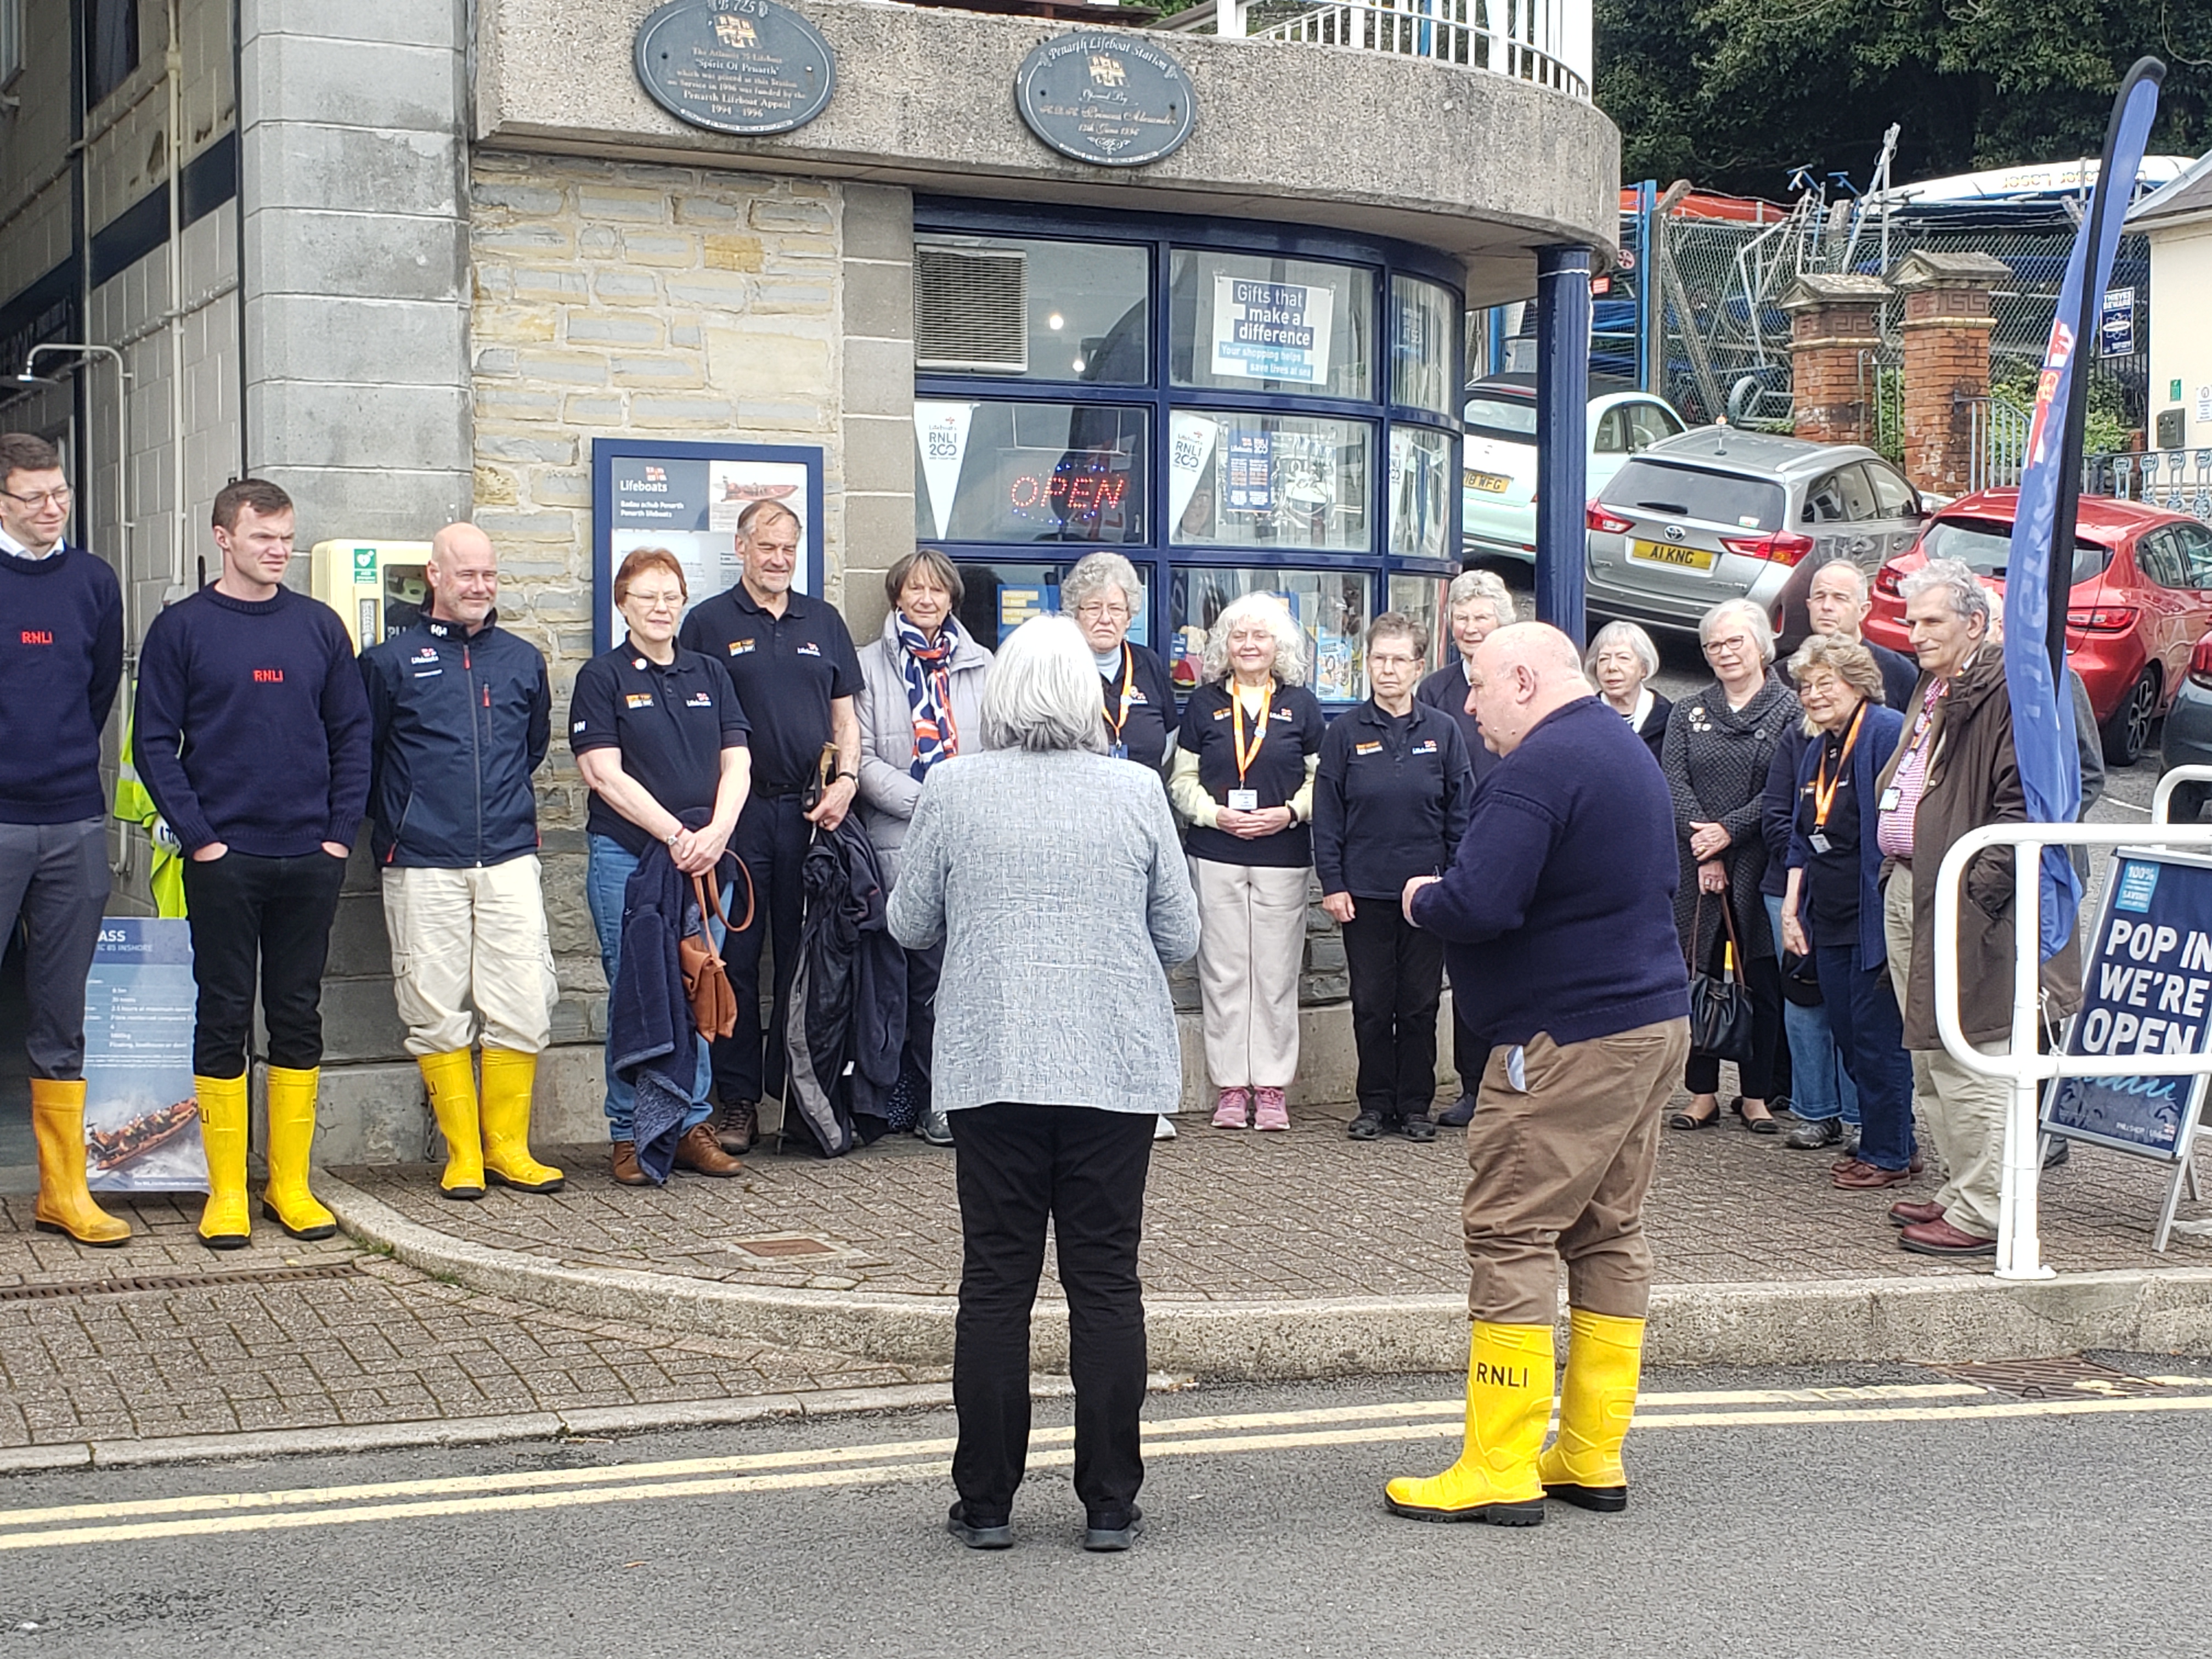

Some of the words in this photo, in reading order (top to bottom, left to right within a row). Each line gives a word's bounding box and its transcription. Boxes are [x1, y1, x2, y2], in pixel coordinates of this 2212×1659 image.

[733, 0, 755, 13] 725
[692, 47, 706, 55] The
[709, 49, 738, 59] Atlantic
[753, 54, 782, 64] Lifeboat
[1048, 37, 1088, 60] Penarth
[1089, 37, 1131, 53] Lifeboat
[1131, 46, 1167, 71] Station
[726, 60, 738, 71] Of
[677, 70, 699, 78] which
[718, 74, 741, 82] placed
[754, 77, 768, 85] this
[771, 78, 797, 88] Station
[680, 79, 706, 89] Service
[720, 83, 737, 92] 1996
[754, 86, 781, 97] funded
[783, 90, 792, 99] by
[794, 91, 806, 99] the
[683, 90, 719, 102] Penarth
[722, 94, 758, 106] Lifeboat
[760, 99, 791, 109] Appeal
[742, 108, 764, 118] 1996
[1237, 284, 1271, 303] Gifts
[1275, 289, 1303, 307] that
[1249, 307, 1289, 324] make
[1292, 312, 1300, 326] a
[1239, 323, 1311, 346] difference
[1221, 344, 1242, 354] Your
[1242, 347, 1279, 362] shopping
[1280, 352, 1301, 362] helps
[1250, 363, 1268, 373] save
[1270, 363, 1289, 374] lives
[1290, 367, 1297, 375] at
[1299, 368, 1311, 377] sea
[929, 432, 957, 443] RNLI
[929, 443, 957, 456] 200
[1176, 441, 1202, 457] RNLI
[1174, 452, 1199, 468] 200
[620, 479, 668, 492] Lifeboats
[1464, 471, 1476, 485] 18
[1479, 475, 1502, 490] WFG
[1012, 476, 1125, 509] OPEN
[660, 501, 684, 510] Penarth
[1666, 549, 1695, 565] KNG
[22, 630, 53, 644] RNLI
[253, 669, 284, 683] RNLI
[2128, 865, 2155, 881] 100%
[98, 929, 126, 943] ASS
[118, 944, 153, 952] INSHORE
[2105, 918, 2177, 963] POP
[2179, 930, 2212, 973] IN
[2100, 962, 2211, 1018] WE'RE
[2083, 1008, 2198, 1055] OPEN
[1476, 1361, 1528, 1388] RNLI
